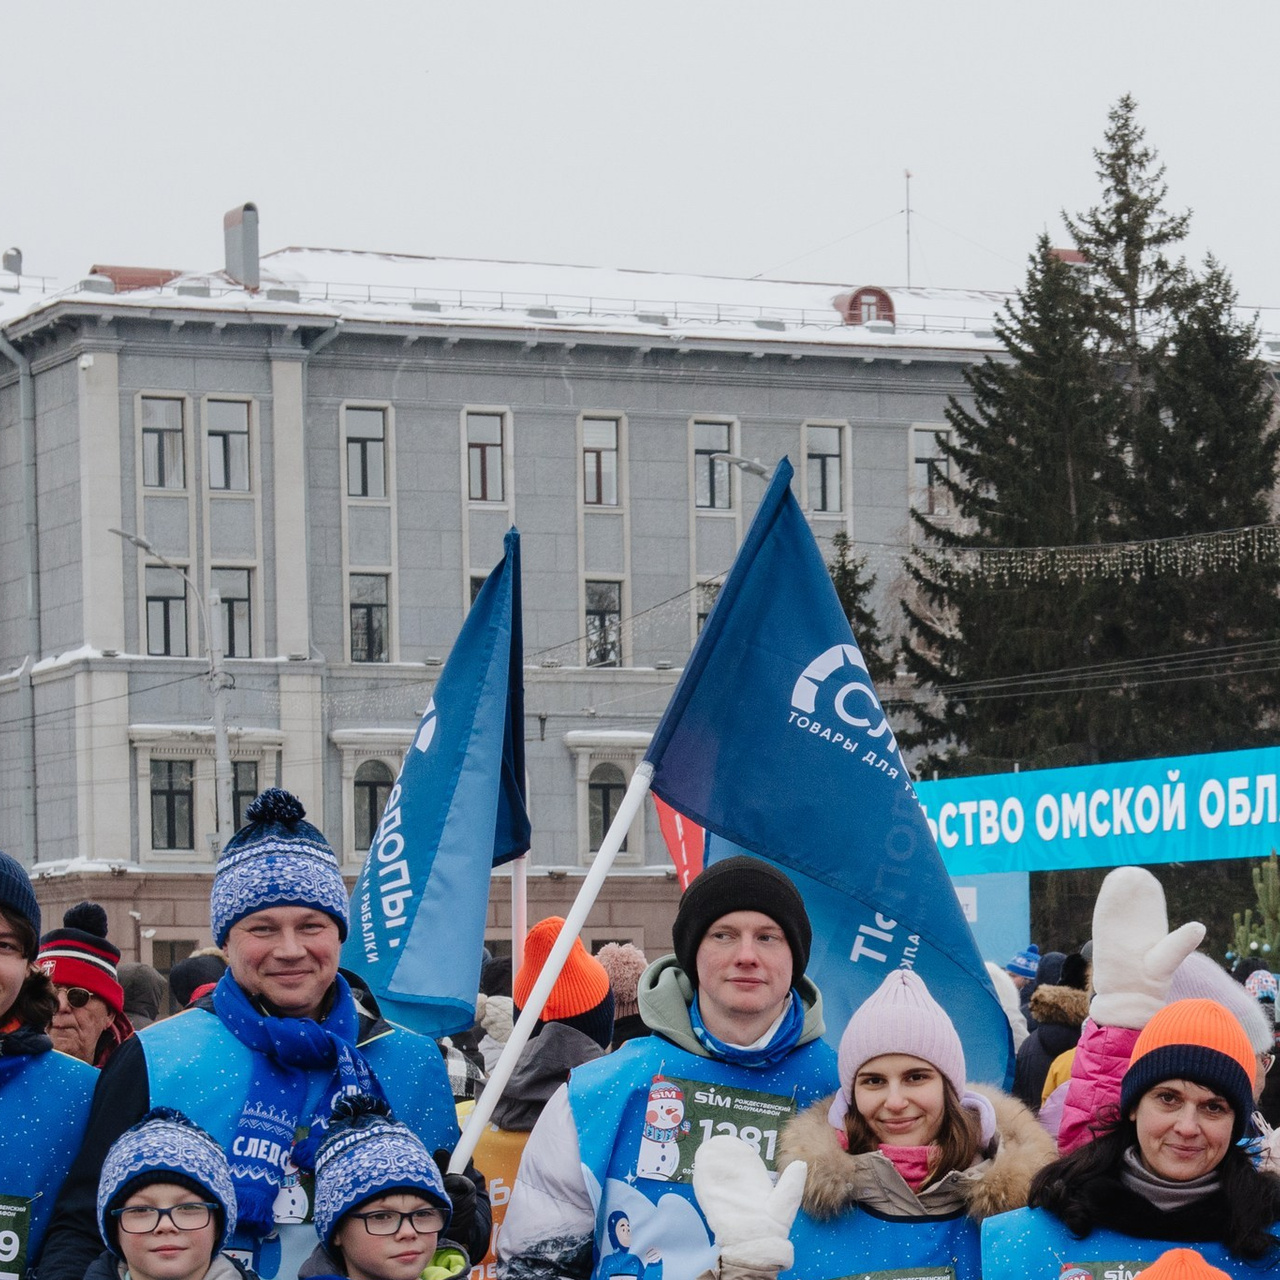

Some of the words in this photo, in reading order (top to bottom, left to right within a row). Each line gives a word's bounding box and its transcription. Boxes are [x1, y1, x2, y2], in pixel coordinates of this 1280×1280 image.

[788, 711, 859, 753] ТОВАРЫ
[862, 750, 899, 780] ДЛЯ
[1035, 769, 1186, 841] ОМСКОЙ
[361, 893, 379, 963] РЫБАЛКИ
[733, 1103, 781, 1116] ПОЛУМАРАФОН
[734, 1097, 791, 1112] РОЖДЕСТВЕНСКИЙ
